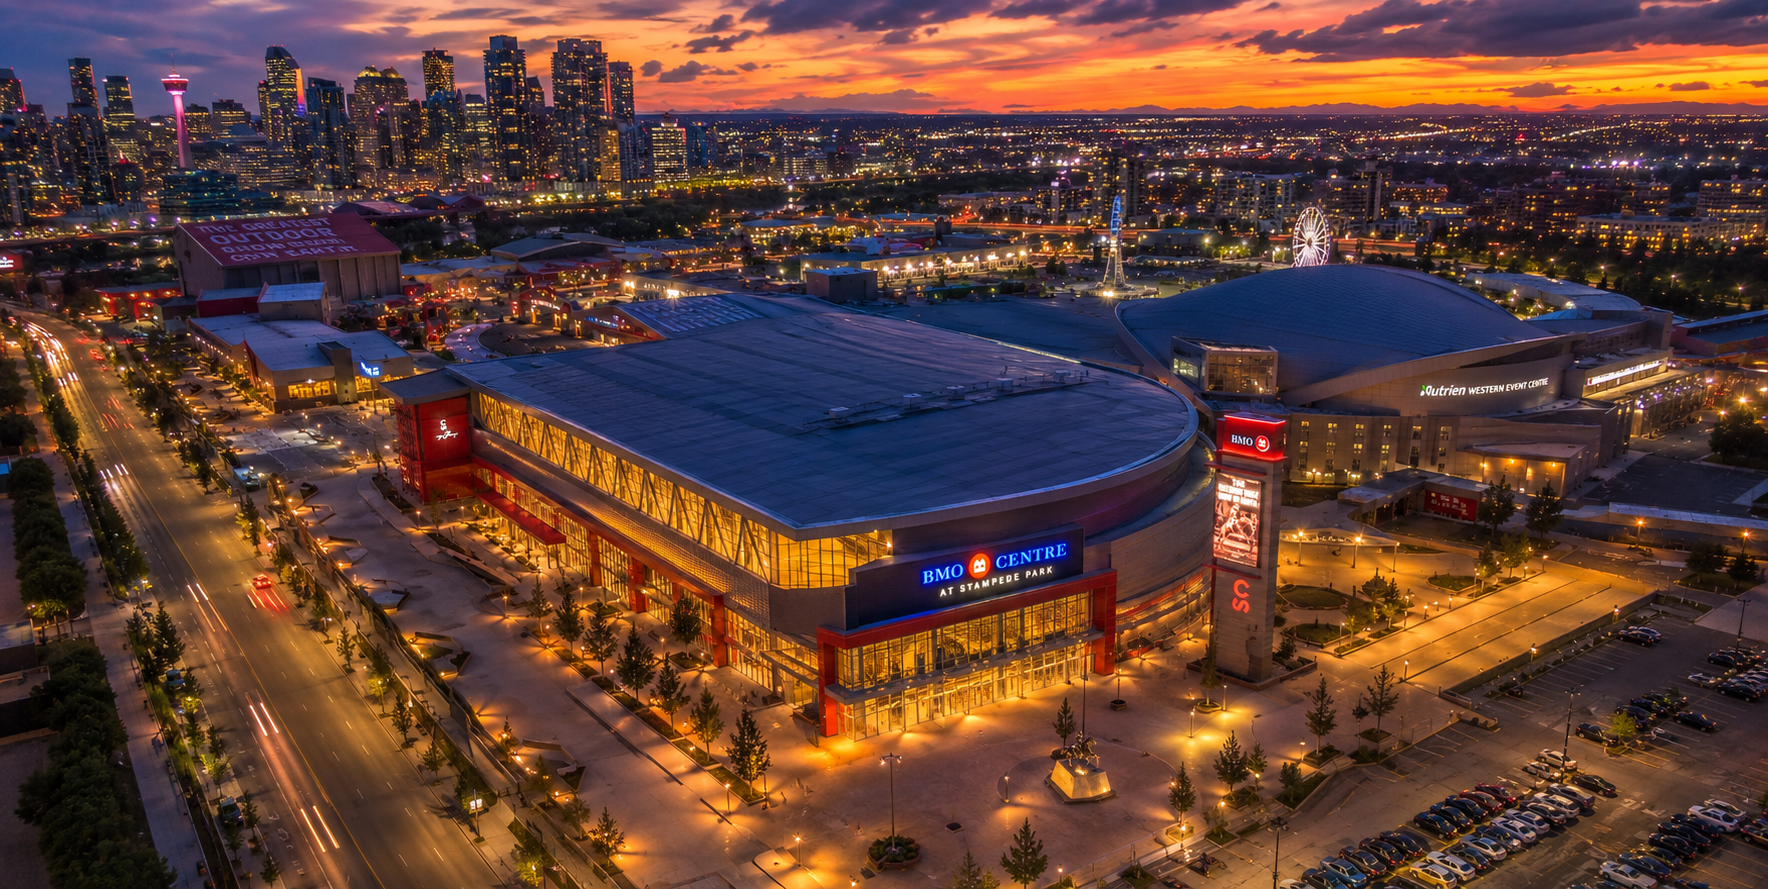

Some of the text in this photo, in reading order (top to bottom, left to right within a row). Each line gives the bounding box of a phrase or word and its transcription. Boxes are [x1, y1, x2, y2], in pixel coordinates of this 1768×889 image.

[210, 227, 338, 244] OUTDOOR
[1468, 384, 1505, 395] WESTERN
[1505, 381, 1528, 392] EVENT
[1231, 434, 1253, 447] BMO
[922, 543, 1068, 585] BMO CENTRE
[939, 566, 1053, 597] AT STAMPEDE PARK
